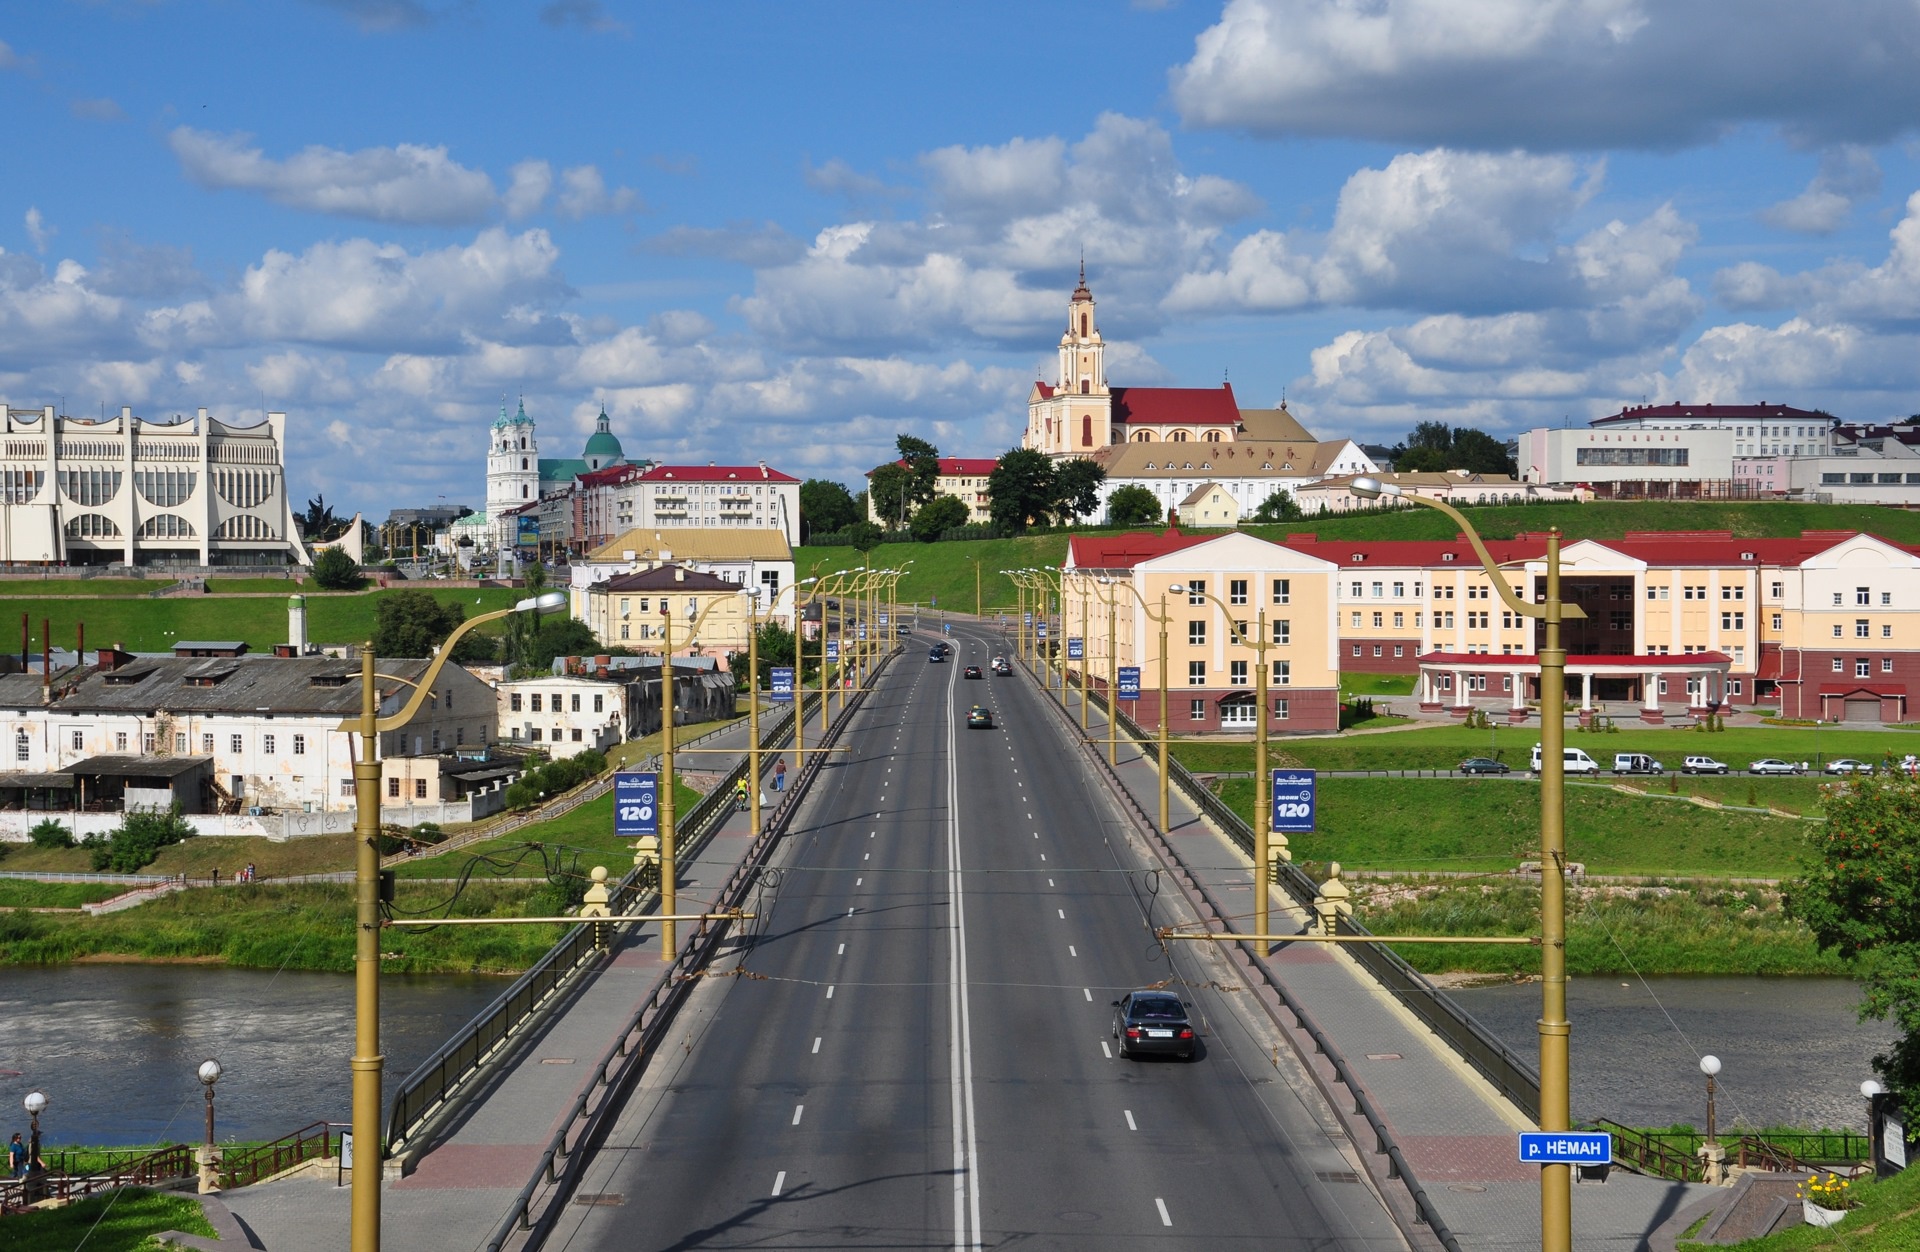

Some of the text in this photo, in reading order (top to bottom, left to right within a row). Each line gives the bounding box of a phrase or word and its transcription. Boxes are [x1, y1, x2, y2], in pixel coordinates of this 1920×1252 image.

[619, 806, 653, 821] 120
[1277, 803, 1310, 818] 120
[1529, 1139, 1601, 1157] р. НЁМАН
